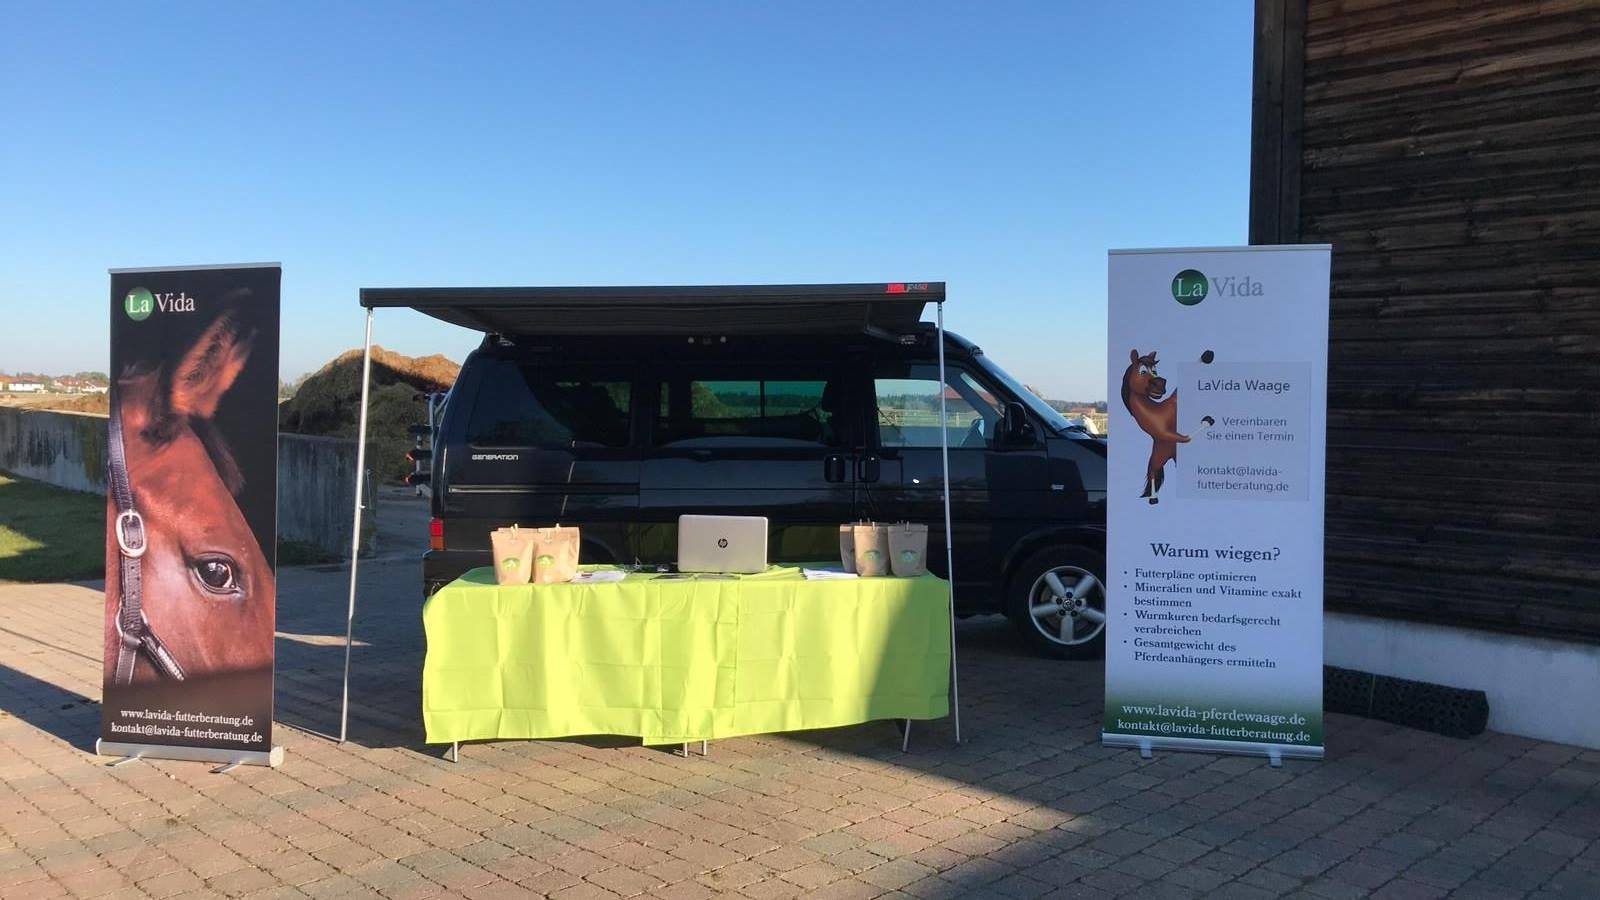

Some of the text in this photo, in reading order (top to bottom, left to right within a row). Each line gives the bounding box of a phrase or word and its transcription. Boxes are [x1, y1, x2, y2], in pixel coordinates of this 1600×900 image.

[1175, 276, 1265, 298] La Vida
[127, 292, 196, 313] La Vida
[1197, 379, 1291, 394] LaVida Waage
[1221, 416, 1287, 427] Vereinbaren
[1206, 431, 1295, 442] Sie einen Termin
[1197, 465, 1283, 477] kontakt@lavida-
[1197, 479, 1290, 493] futterberatung.de
[1150, 543, 1282, 563] Warum wiegen?
[1134, 568, 1257, 582] Futterpläne optimieren
[1134, 582, 1302, 599] Mineralien und Vitamine exakt
[1134, 596, 1193, 608] bestimmen
[1134, 610, 1281, 626] Wurmkuren bedarfsgerecht
[1134, 625, 1202, 637] verabreichen
[1133, 637, 1237, 652] Gesamtgewicht des
[1134, 651, 1277, 669] Pferdeanhängers ermitteln
[120, 708, 254, 727] www.lavida-futterberatung.de
[1121, 703, 1307, 726] www.lavida-pferdewaage.de
[111, 721, 263, 744] kontakt@lavida-futterberatung.de
[1117, 718, 1311, 743] kontakt@lavida-futterberatung.de
